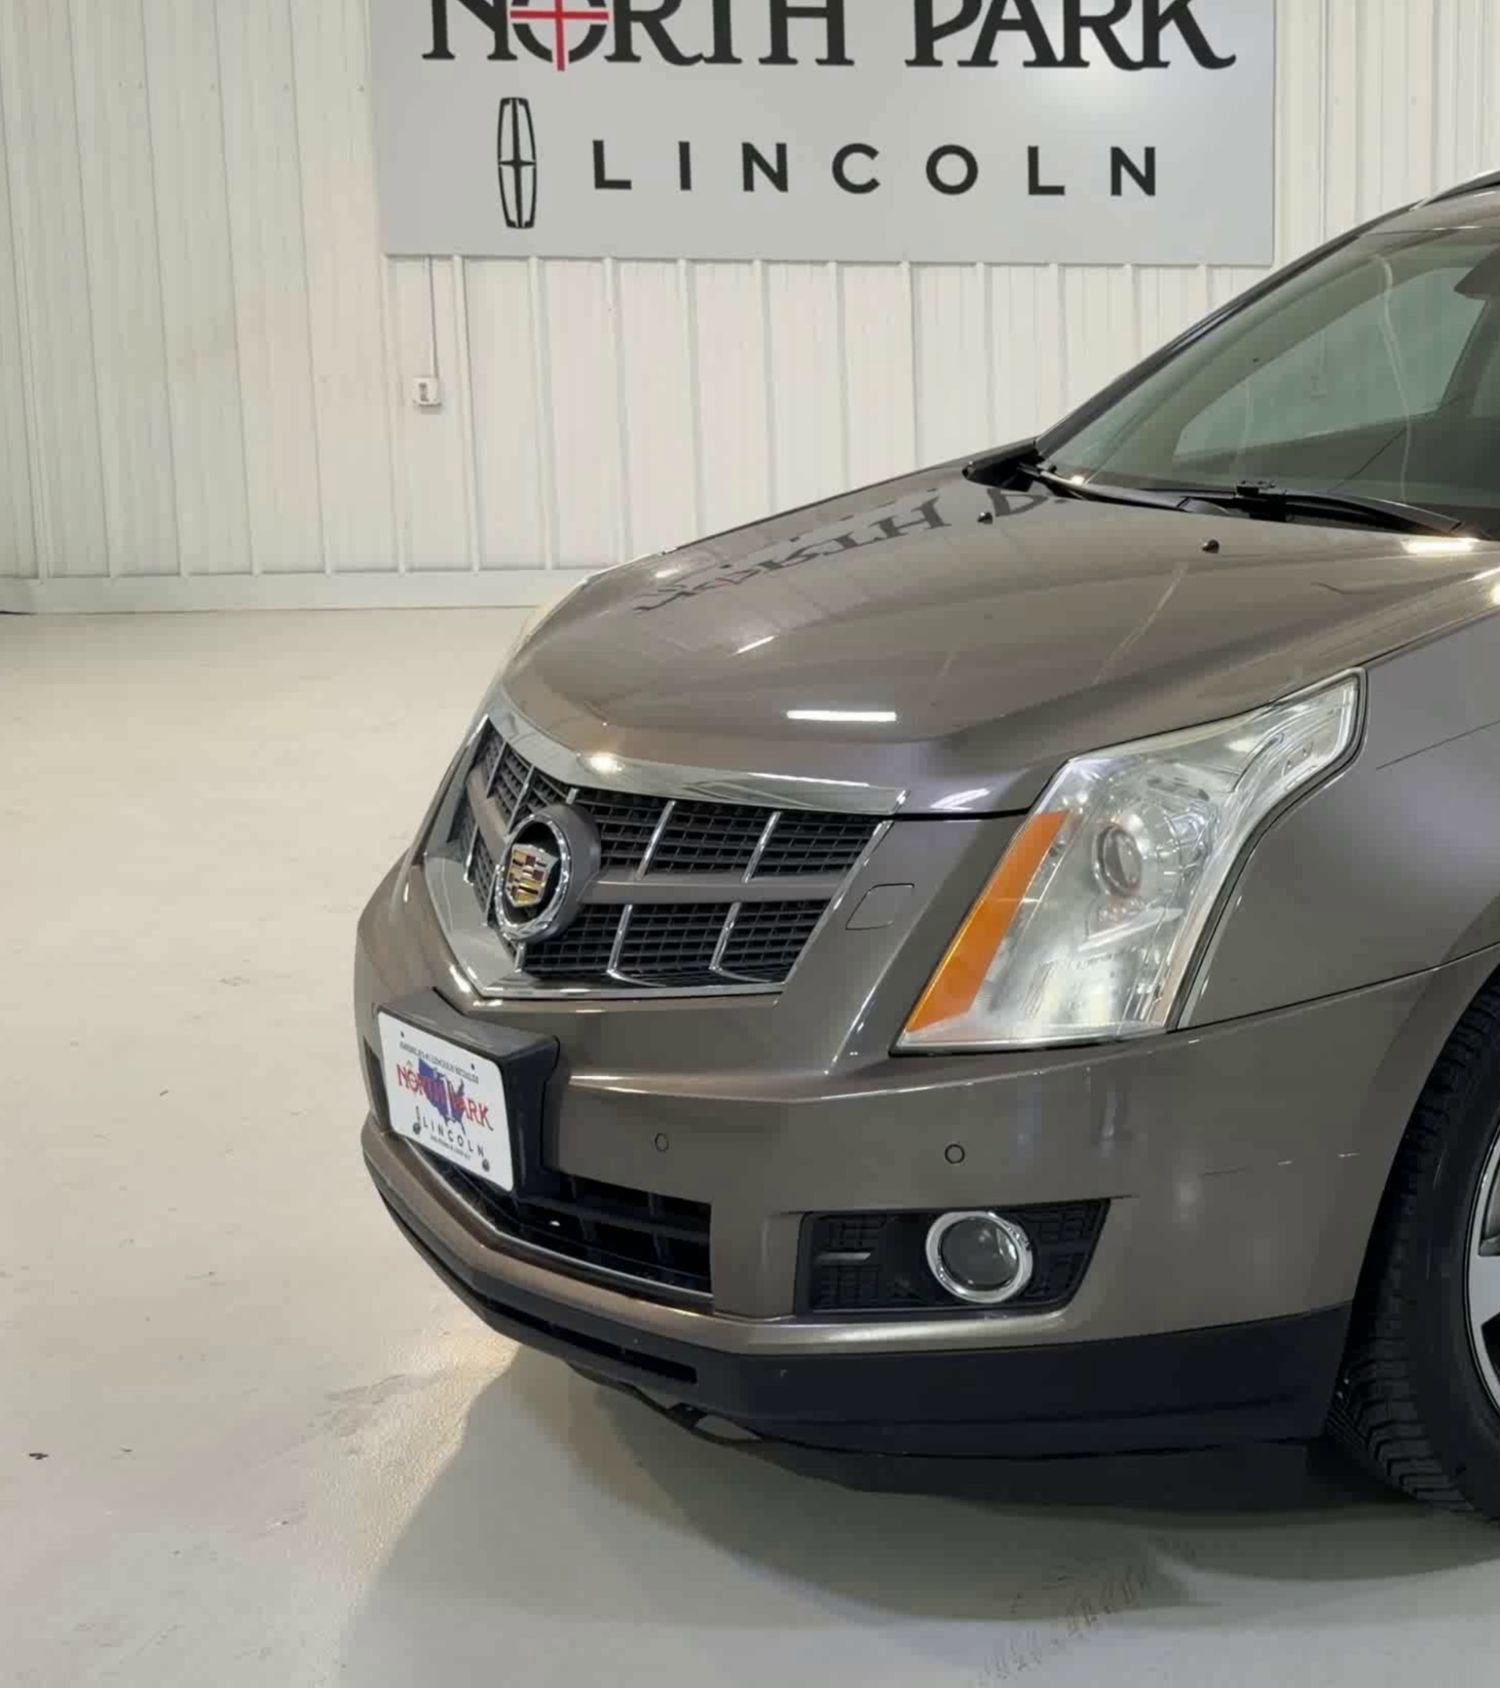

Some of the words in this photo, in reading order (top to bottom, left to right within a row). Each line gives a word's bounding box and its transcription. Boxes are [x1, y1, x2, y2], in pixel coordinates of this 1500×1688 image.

[905, 0, 1237, 71] PARK
[592, 139, 1156, 196] LINCOLN
[422, 1115, 485, 1158] LINCOLN
